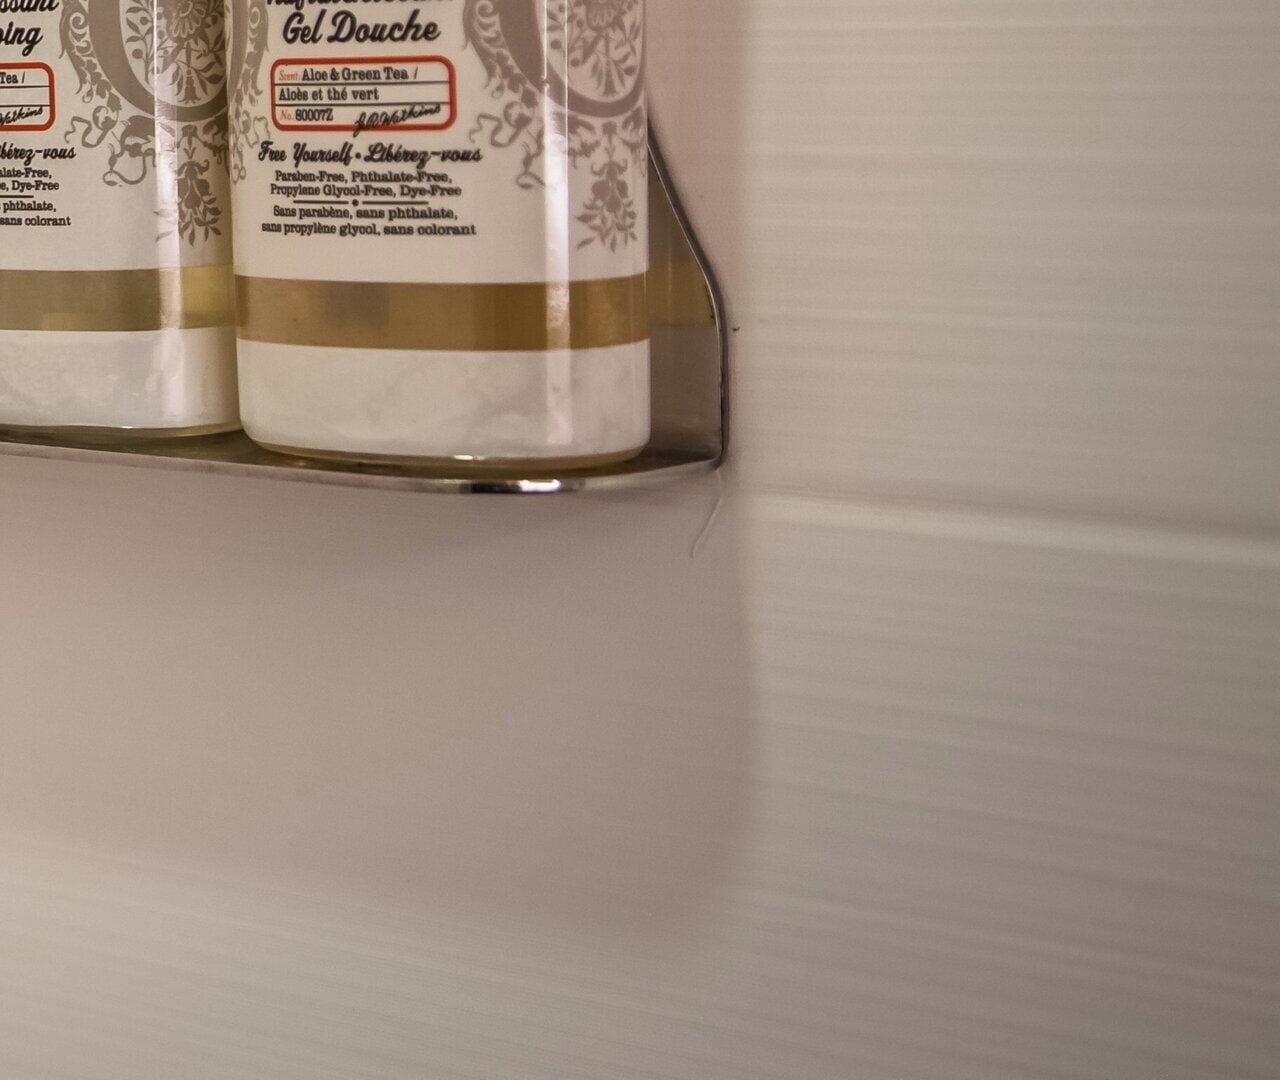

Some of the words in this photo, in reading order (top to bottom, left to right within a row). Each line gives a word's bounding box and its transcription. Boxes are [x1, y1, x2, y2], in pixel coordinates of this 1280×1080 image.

[282, 8, 327, 44] Gel
[327, 8, 441, 43] Douche
[0, 72, 18, 84] Tea
[302, 68, 328, 81] Aloe
[330, 69, 339, 81] &
[341, 67, 381, 81] Green
[383, 67, 409, 80] Tea
[279, 87, 308, 101] Aloès
[311, 89, 324, 101] et
[327, 87, 347, 101] thé
[352, 88, 379, 101] vert
[295, 108, 334, 121] 80007Z
[258, 140, 287, 162] Free
[292, 141, 353, 168] Yourself
[364, 142, 484, 170] Libérez-vous
[275, 170, 348, 183] Paraben-Free,
[351, 170, 452, 183] Phthalate-Free,
[11, 180, 60, 192] Dye-Free
[270, 184, 320, 198] Propylene
[323, 184, 396, 198] Glycol-Free,
[400, 185, 462, 198] Dye-Free
[3, 200, 57, 213] phthalate,
[273, 206, 297, 217] Sans
[299, 206, 353, 220] parabène,
[356, 209, 385, 218] sans
[388, 207, 457, 221] phthalate,
[0, 217, 22, 225] sans
[24, 215, 71, 226] colorant
[261, 223, 282, 232] sans
[284, 221, 337, 236] propylène
[339, 223, 381, 237] glycol,
[384, 225, 414, 235] sans
[417, 224, 476, 235] colorant
